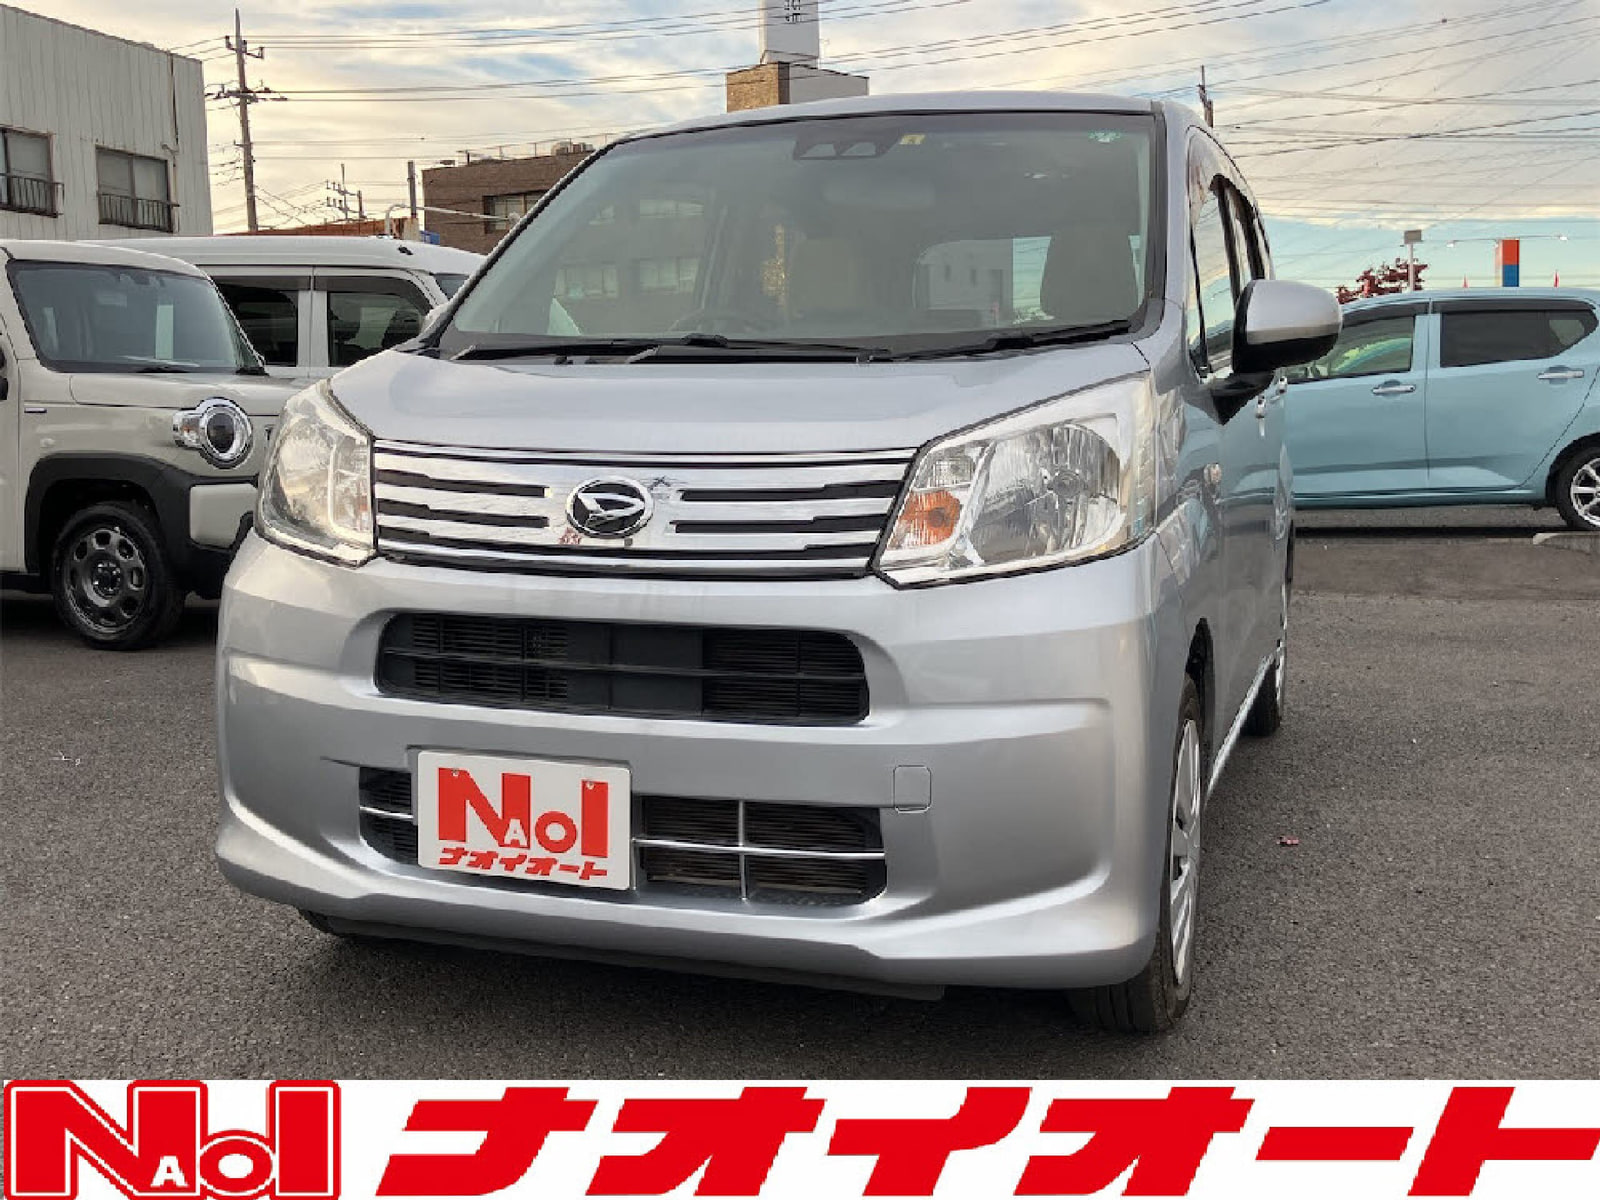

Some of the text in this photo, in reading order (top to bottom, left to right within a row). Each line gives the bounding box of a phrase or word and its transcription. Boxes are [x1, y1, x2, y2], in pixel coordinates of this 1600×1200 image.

[438, 847, 608, 881] ナオイオート
